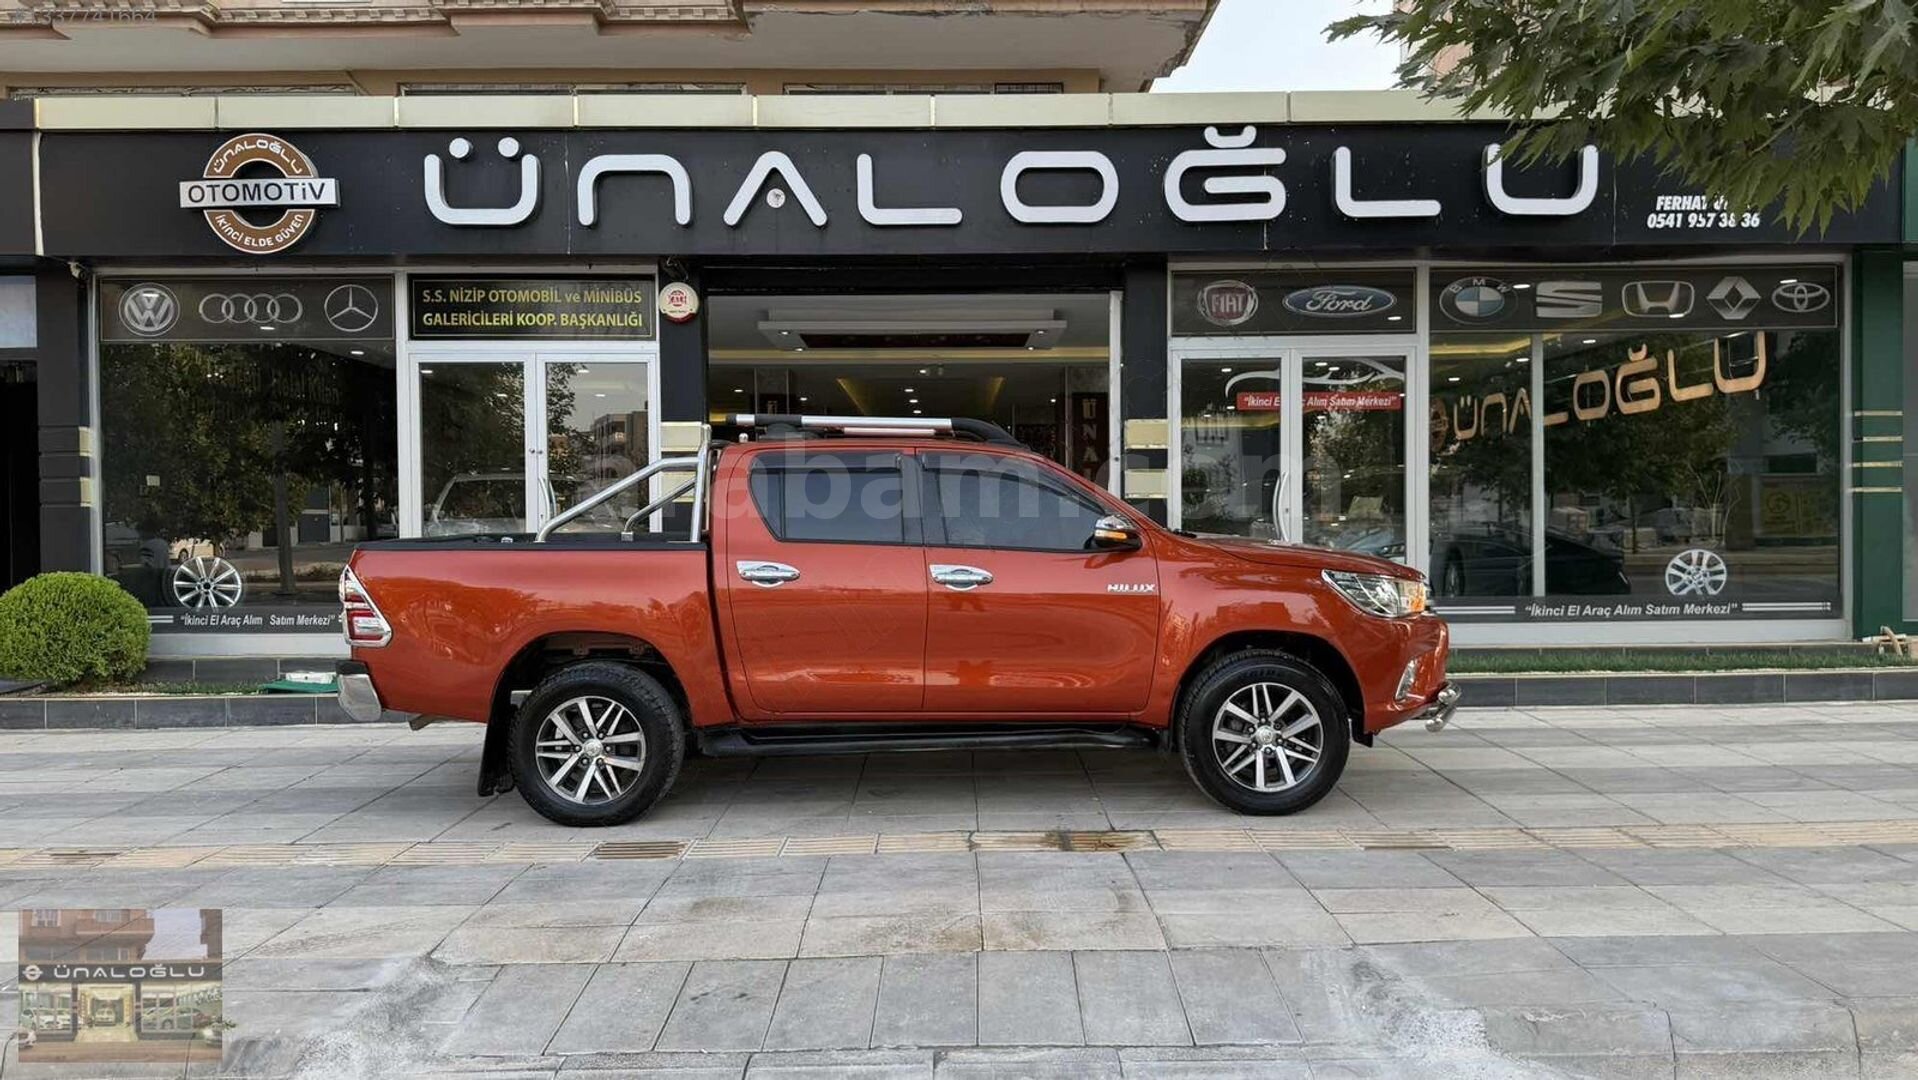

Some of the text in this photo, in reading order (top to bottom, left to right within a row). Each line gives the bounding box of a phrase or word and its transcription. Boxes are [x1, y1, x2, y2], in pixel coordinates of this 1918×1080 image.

[213, 139, 303, 174] ÜNALOĞLU
[424, 126, 1599, 228] ÜNALOĞLU
[1646, 213, 1683, 229] 0541
[1740, 212, 1761, 228] 36
[243, 236, 275, 247] ELDE
[274, 214, 305, 243] GÜVEN
[423, 286, 643, 304] S.S. NİZİP OTOMOBİL ve MİNİBÜS
[1211, 292, 1247, 313] FIAT
[1305, 288, 1373, 312] Ford
[422, 311, 643, 330] GALERİCİLERİ KOOP. BAŞKANLIĞI
[1106, 583, 1156, 593] HILUX
[1567, 604, 1581, 617] El
[1582, 604, 1611, 619] Araç
[1614, 603, 1642, 617] Alım
[1645, 603, 1680, 616] Satım
[210, 614, 220, 626] El
[221, 614, 241, 628] Araç
[242, 614, 263, 626] Alım
[269, 614, 295, 626] Satım
